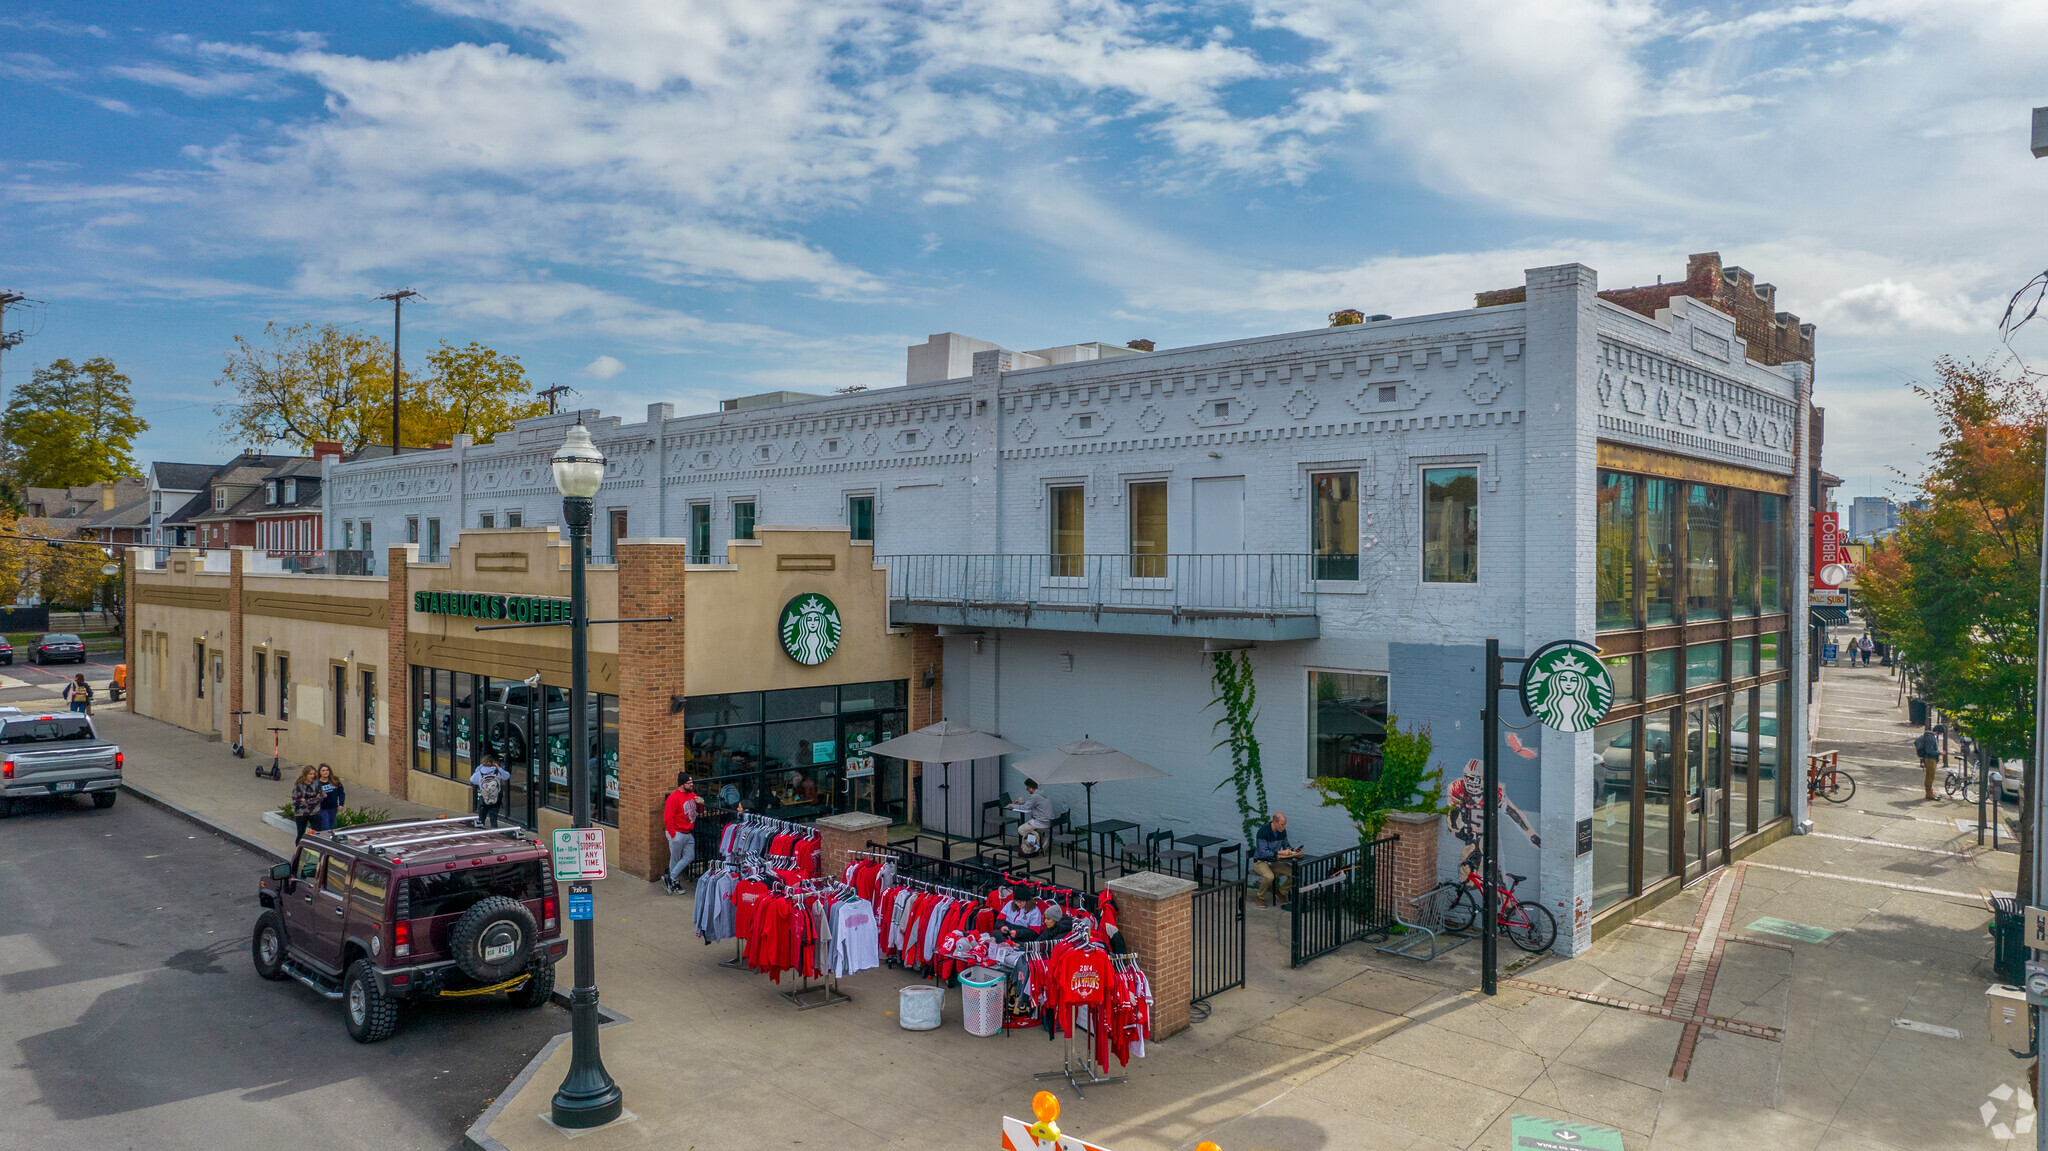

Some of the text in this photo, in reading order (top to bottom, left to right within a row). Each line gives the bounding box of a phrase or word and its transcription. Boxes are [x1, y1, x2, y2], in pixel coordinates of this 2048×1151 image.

[1822, 514, 1836, 562] BIBIBOP
[1826, 595, 1845, 605] SUBS
[414, 591, 571, 626] STARBUCKS COFFEE
[580, 842, 602, 851] STOPPING
[1071, 977, 1100, 991] CHAMPIONS
